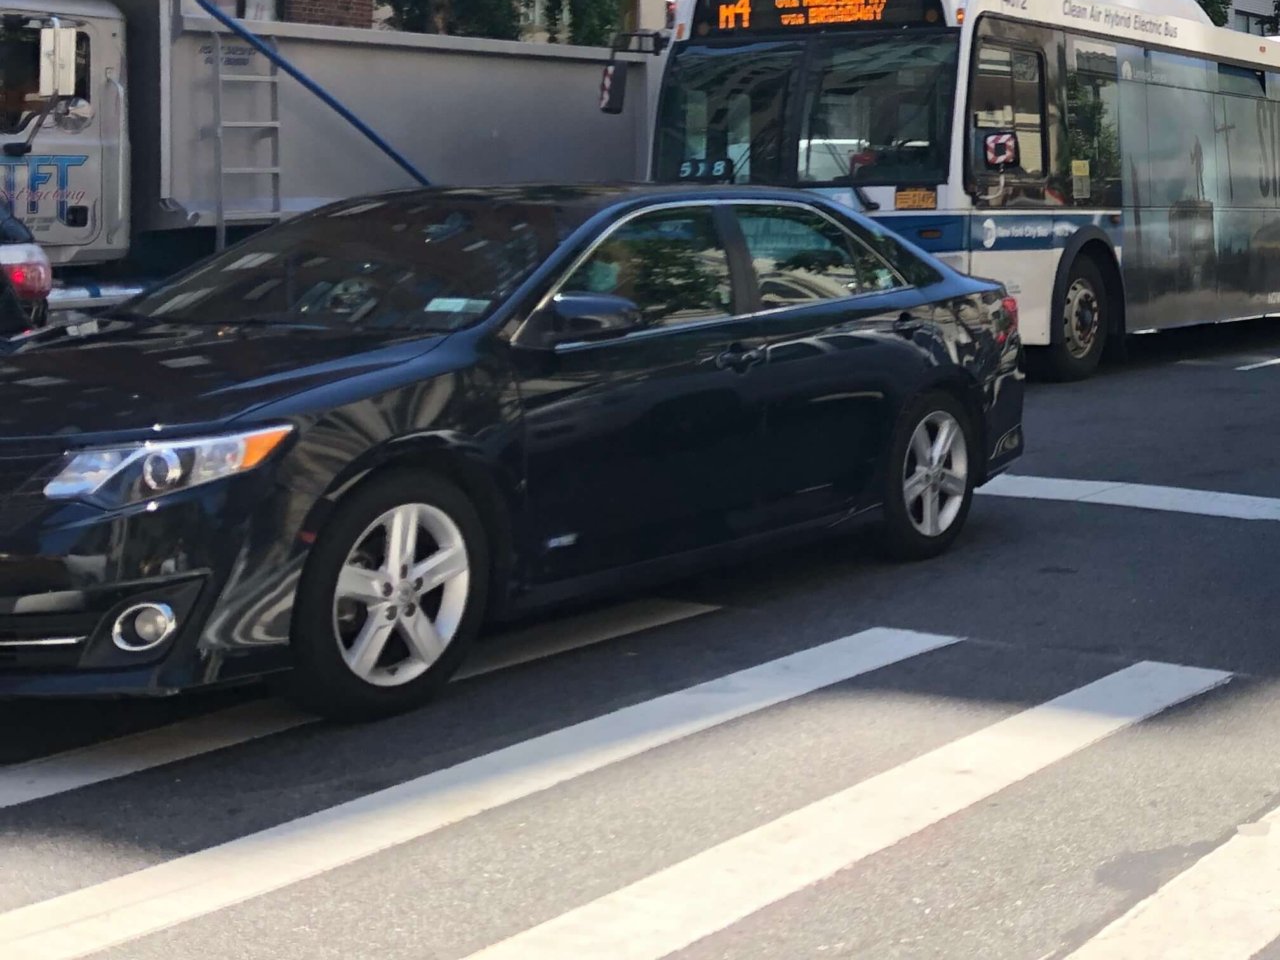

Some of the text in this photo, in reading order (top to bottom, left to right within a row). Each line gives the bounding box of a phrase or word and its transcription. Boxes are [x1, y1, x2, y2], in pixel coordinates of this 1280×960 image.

[1063, 0, 1178, 38] Clean Air Hybrid Electric Bus
